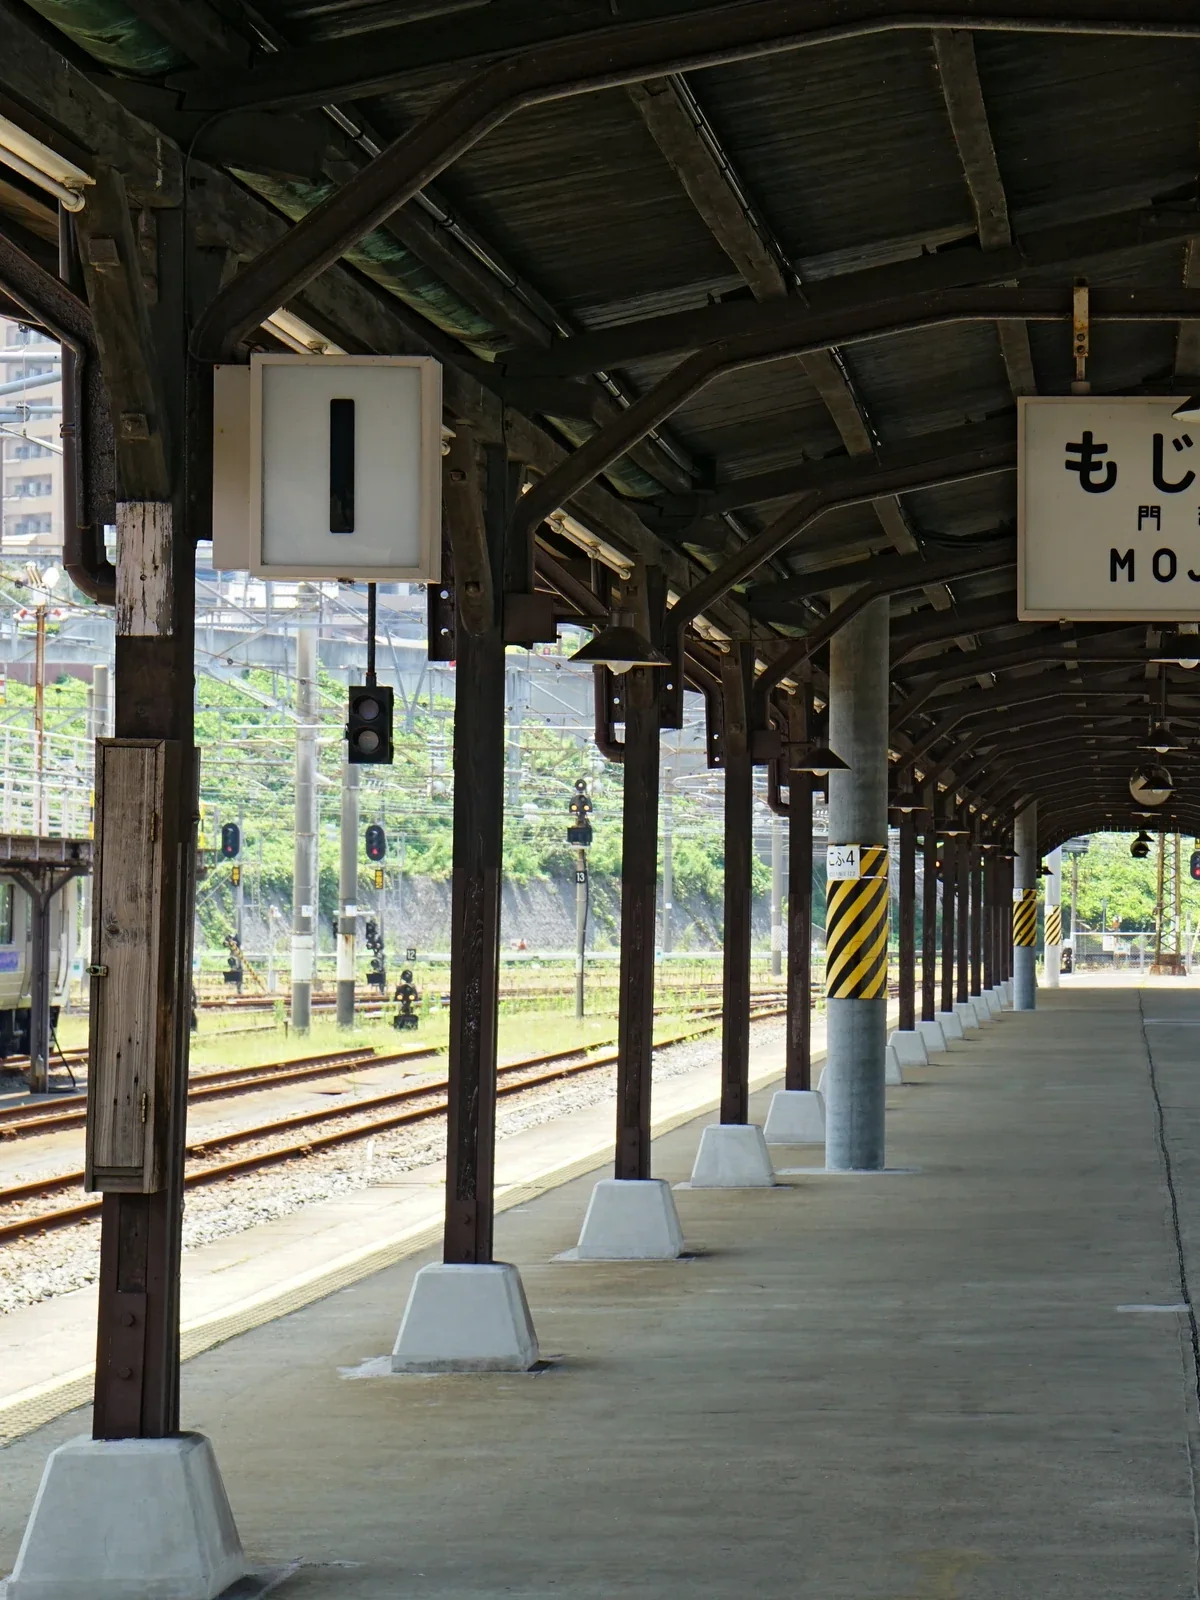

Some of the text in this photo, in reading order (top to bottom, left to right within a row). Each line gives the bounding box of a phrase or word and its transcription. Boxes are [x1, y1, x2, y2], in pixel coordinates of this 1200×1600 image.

[330, 399, 355, 533] 1
[576, 872, 585, 882] 13
[406, 950, 416, 960] 12
